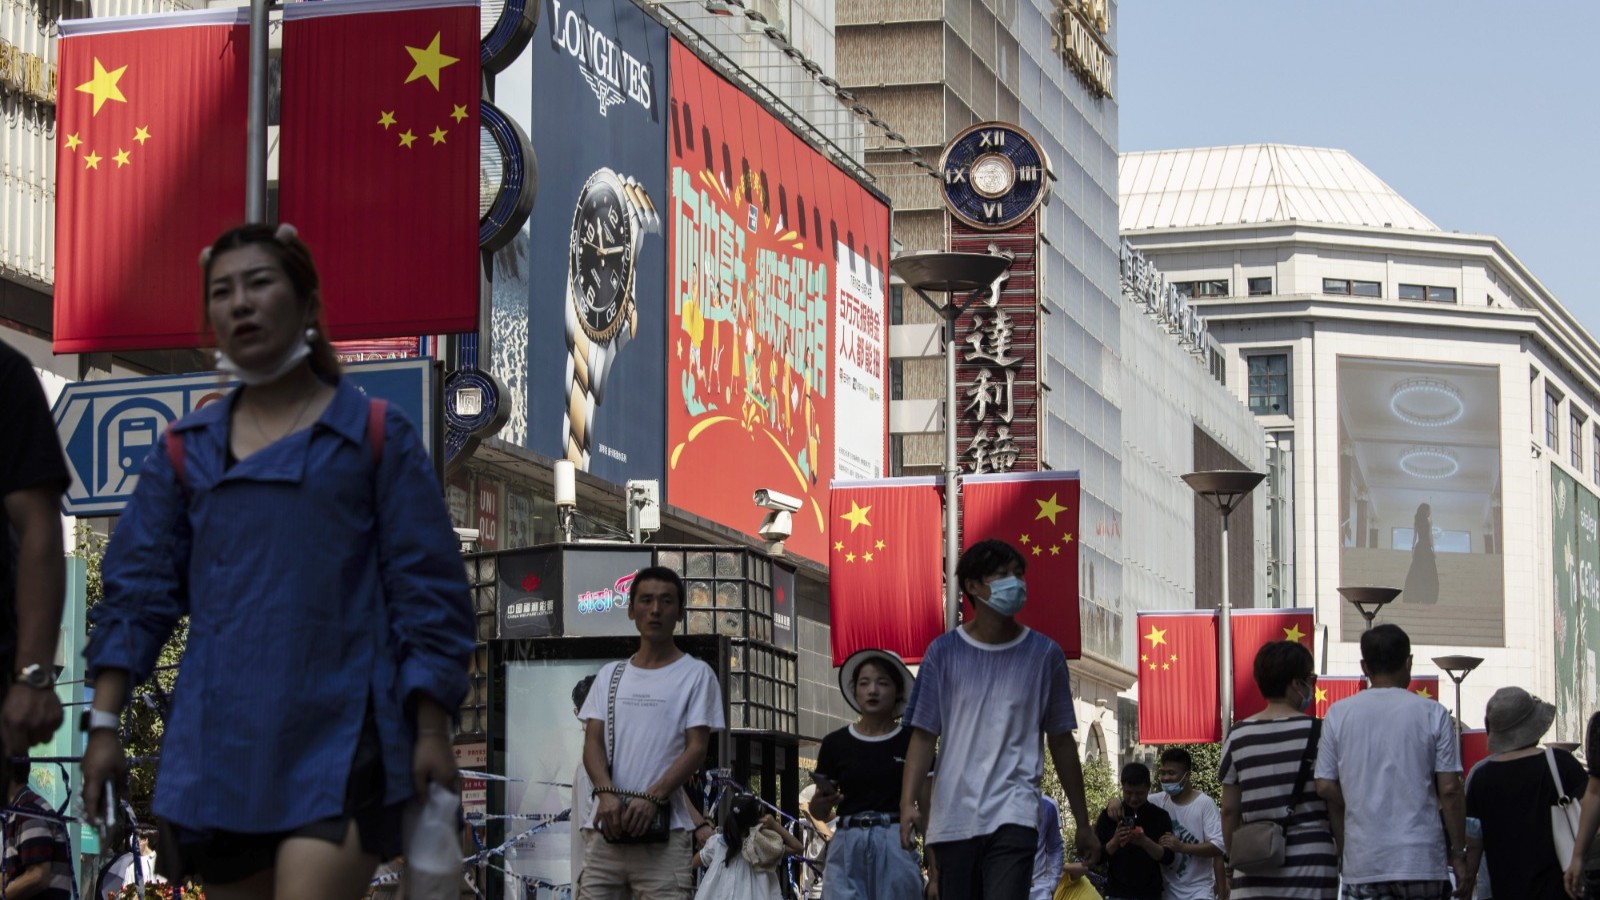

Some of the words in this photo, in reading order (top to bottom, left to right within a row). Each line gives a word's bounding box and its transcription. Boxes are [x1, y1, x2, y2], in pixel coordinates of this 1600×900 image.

[552, 0, 651, 109] LONGINES
[1069, 11, 1113, 99] YOUNGOR
[979, 130, 1005, 147] XII
[982, 202, 1003, 218] VI
[480, 490, 496, 516] UNI
[479, 517, 496, 543] QLO
